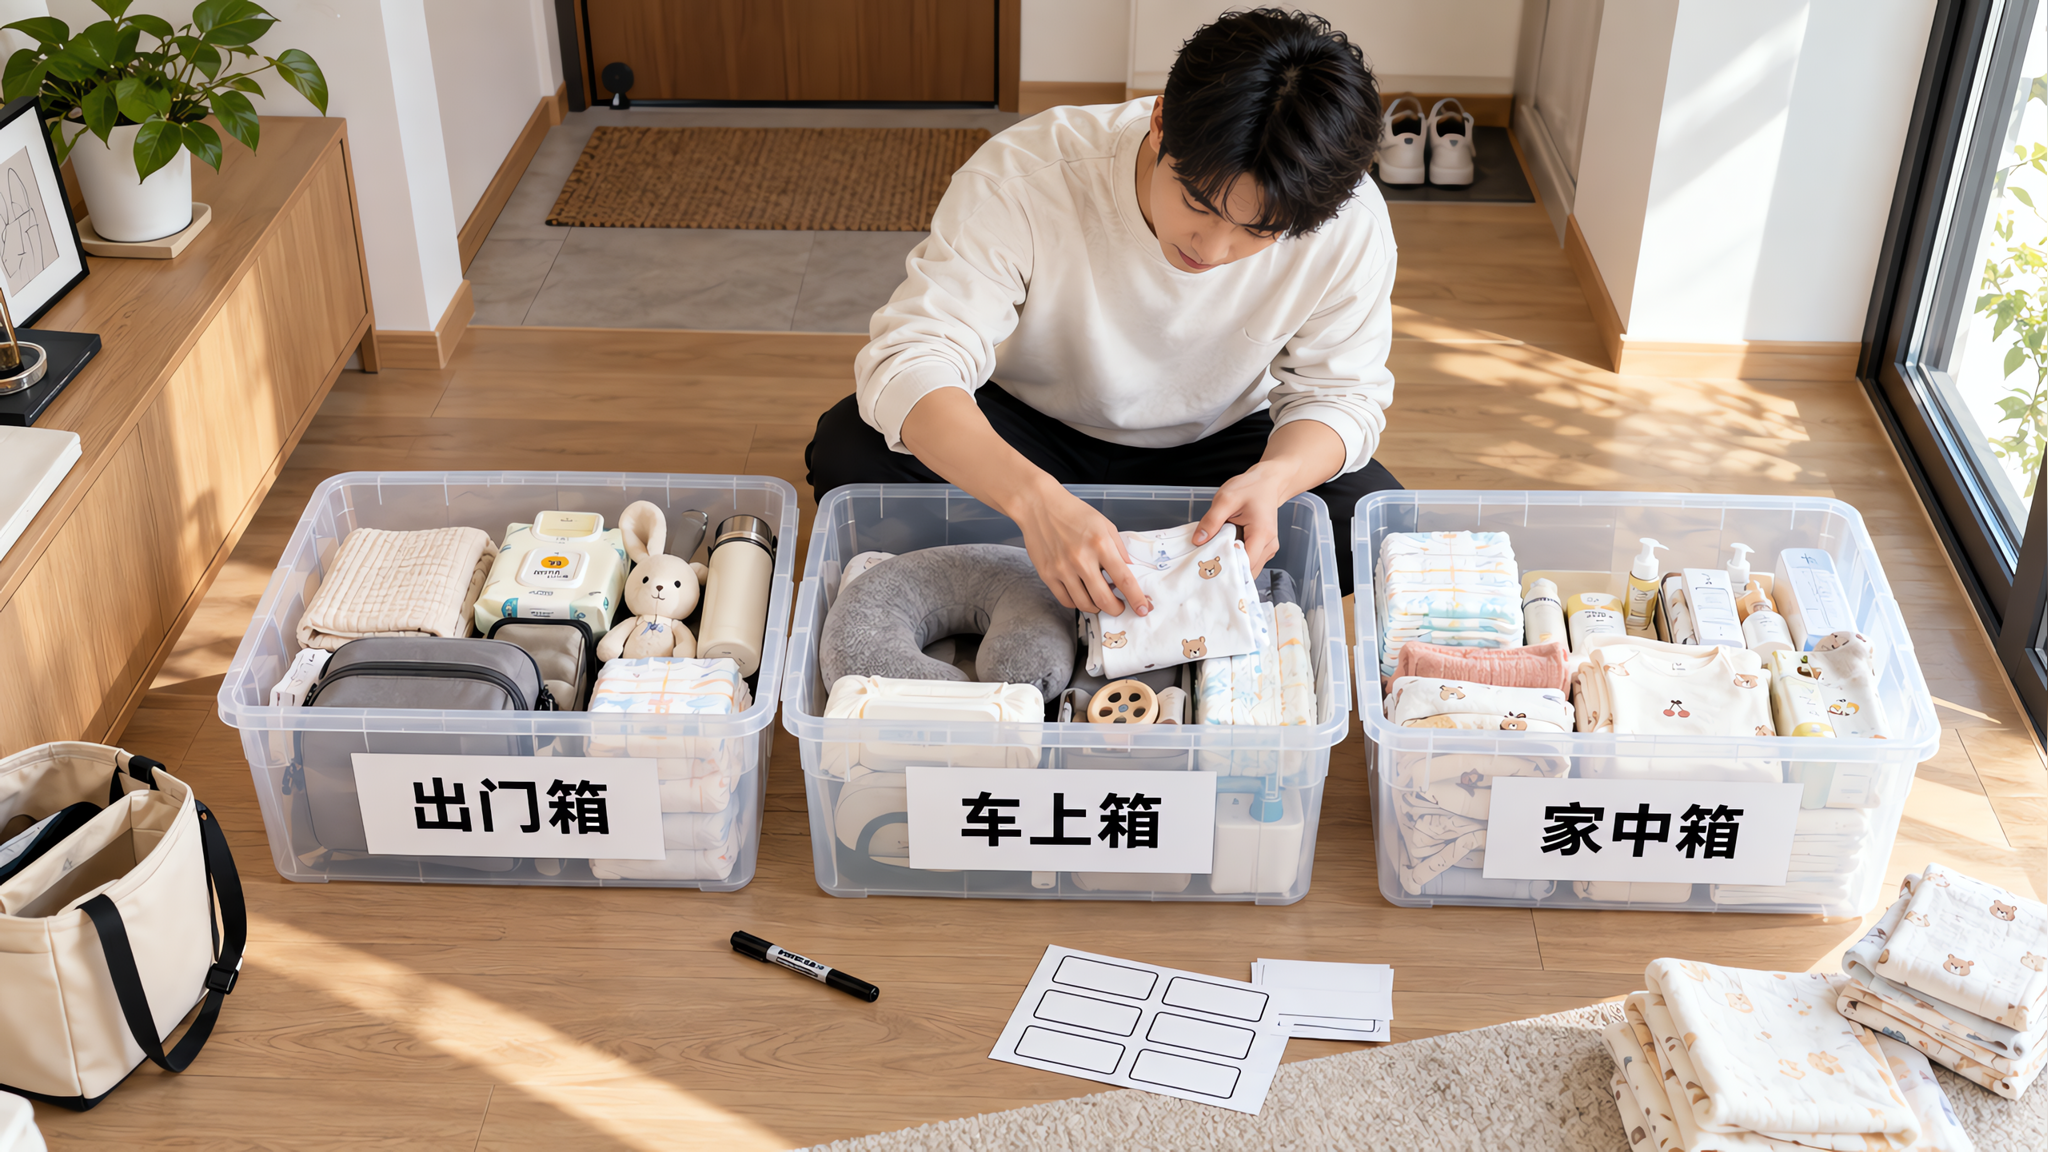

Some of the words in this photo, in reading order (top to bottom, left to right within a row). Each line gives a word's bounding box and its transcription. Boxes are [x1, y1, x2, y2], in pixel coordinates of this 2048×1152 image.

[413, 777, 609, 834] 出门箱
[962, 792, 1161, 848] 车上箱
[1541, 802, 1744, 859] 家中箱
